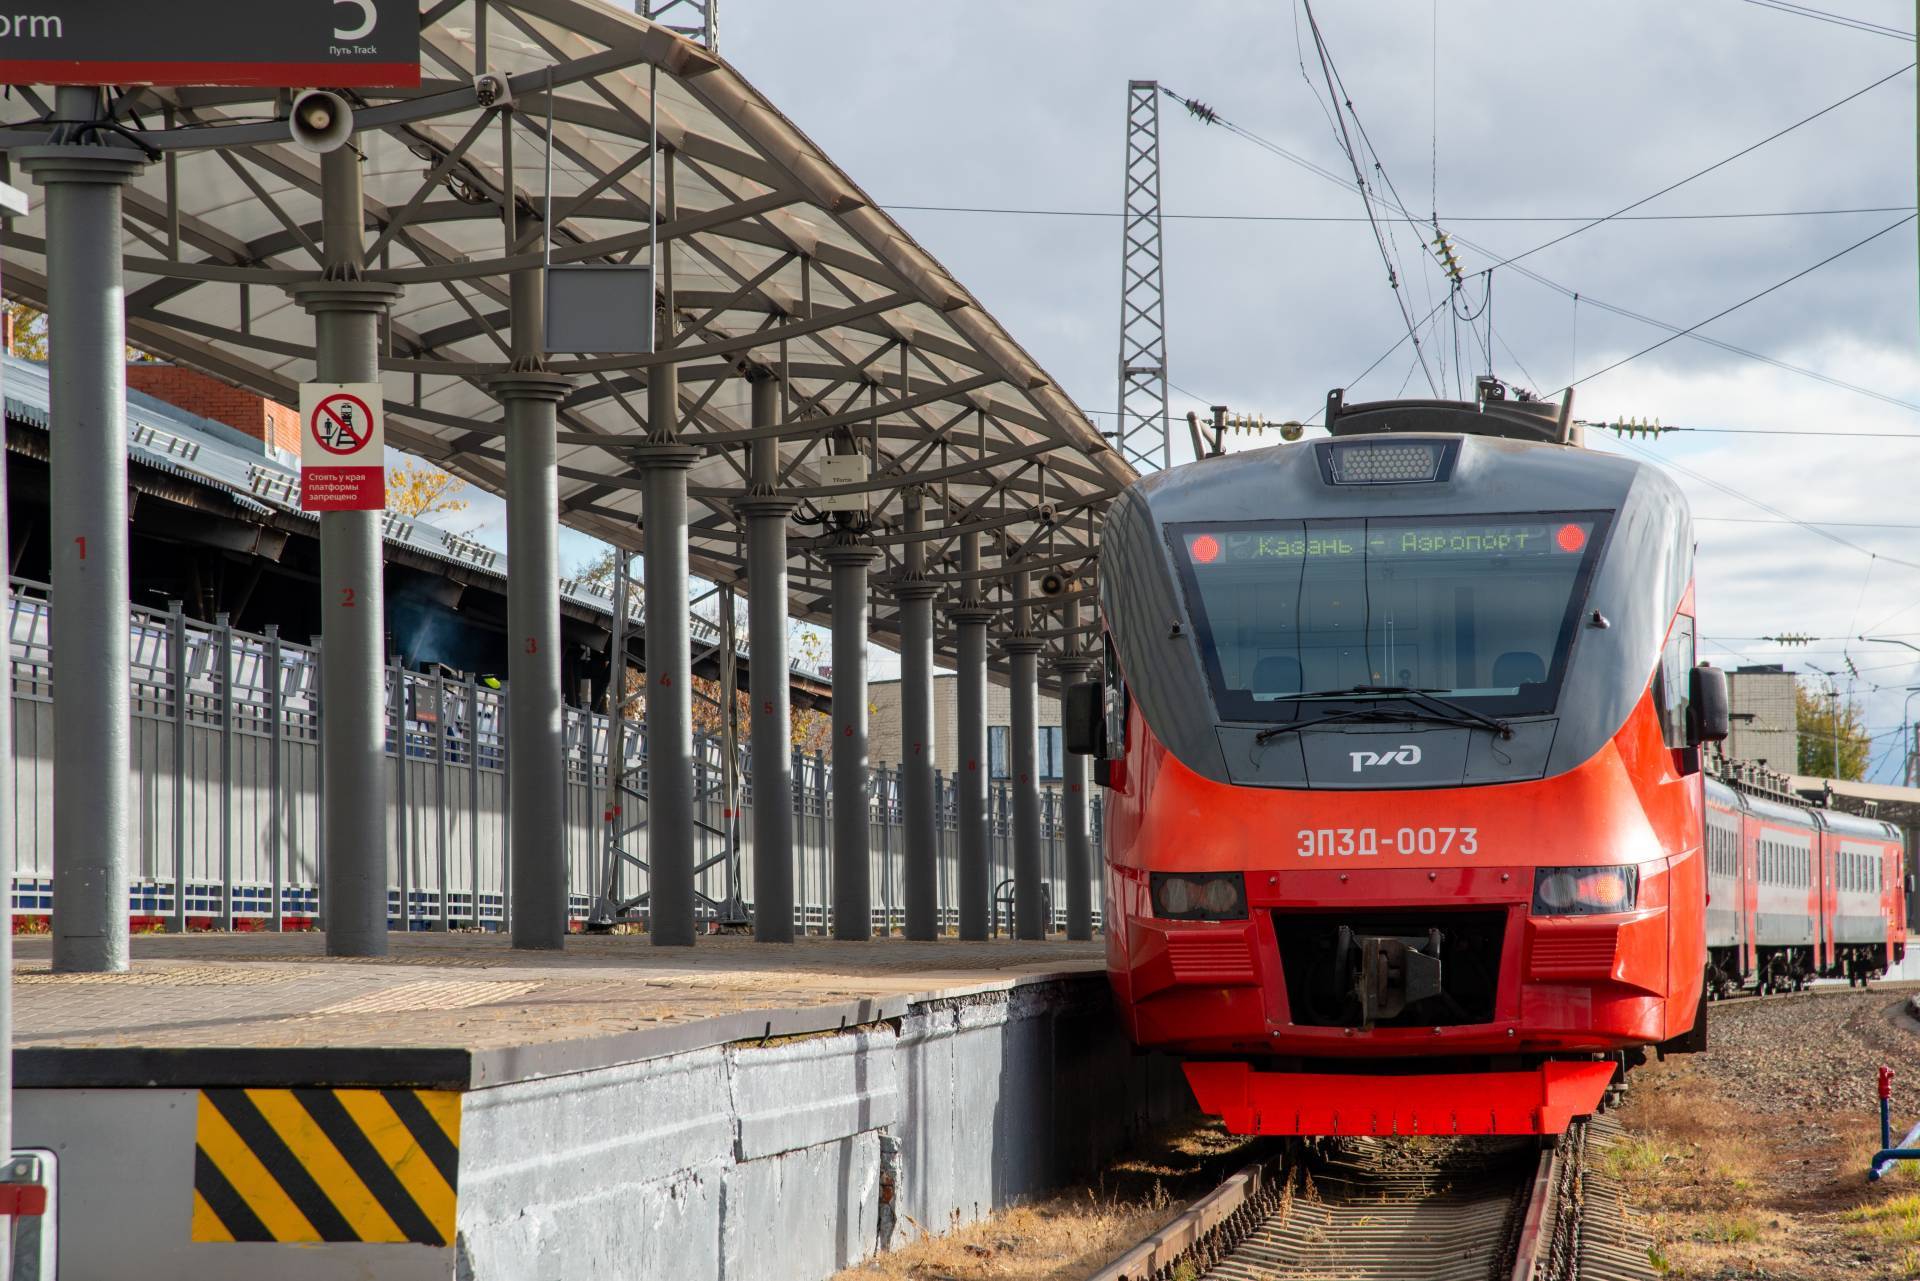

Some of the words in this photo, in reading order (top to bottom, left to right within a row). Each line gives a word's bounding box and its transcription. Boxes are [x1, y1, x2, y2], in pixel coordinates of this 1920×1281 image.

[329, 45, 352, 56] Путь
[353, 45, 377, 54] Track
[308, 473, 338, 481] Стоять
[339, 475, 345, 483] у
[345, 475, 366, 483] края
[308, 483, 359, 492] платформы
[308, 493, 358, 502] запрещено
[74, 536, 86, 560] 1
[1259, 536, 1353, 556] Казань
[1402, 531, 1529, 552] Аэропорт
[340, 587, 356, 608] 2
[527, 637, 538, 655] 3
[658, 671, 672, 687] 4
[763, 702, 773, 715] 5
[913, 742, 922, 754] 7
